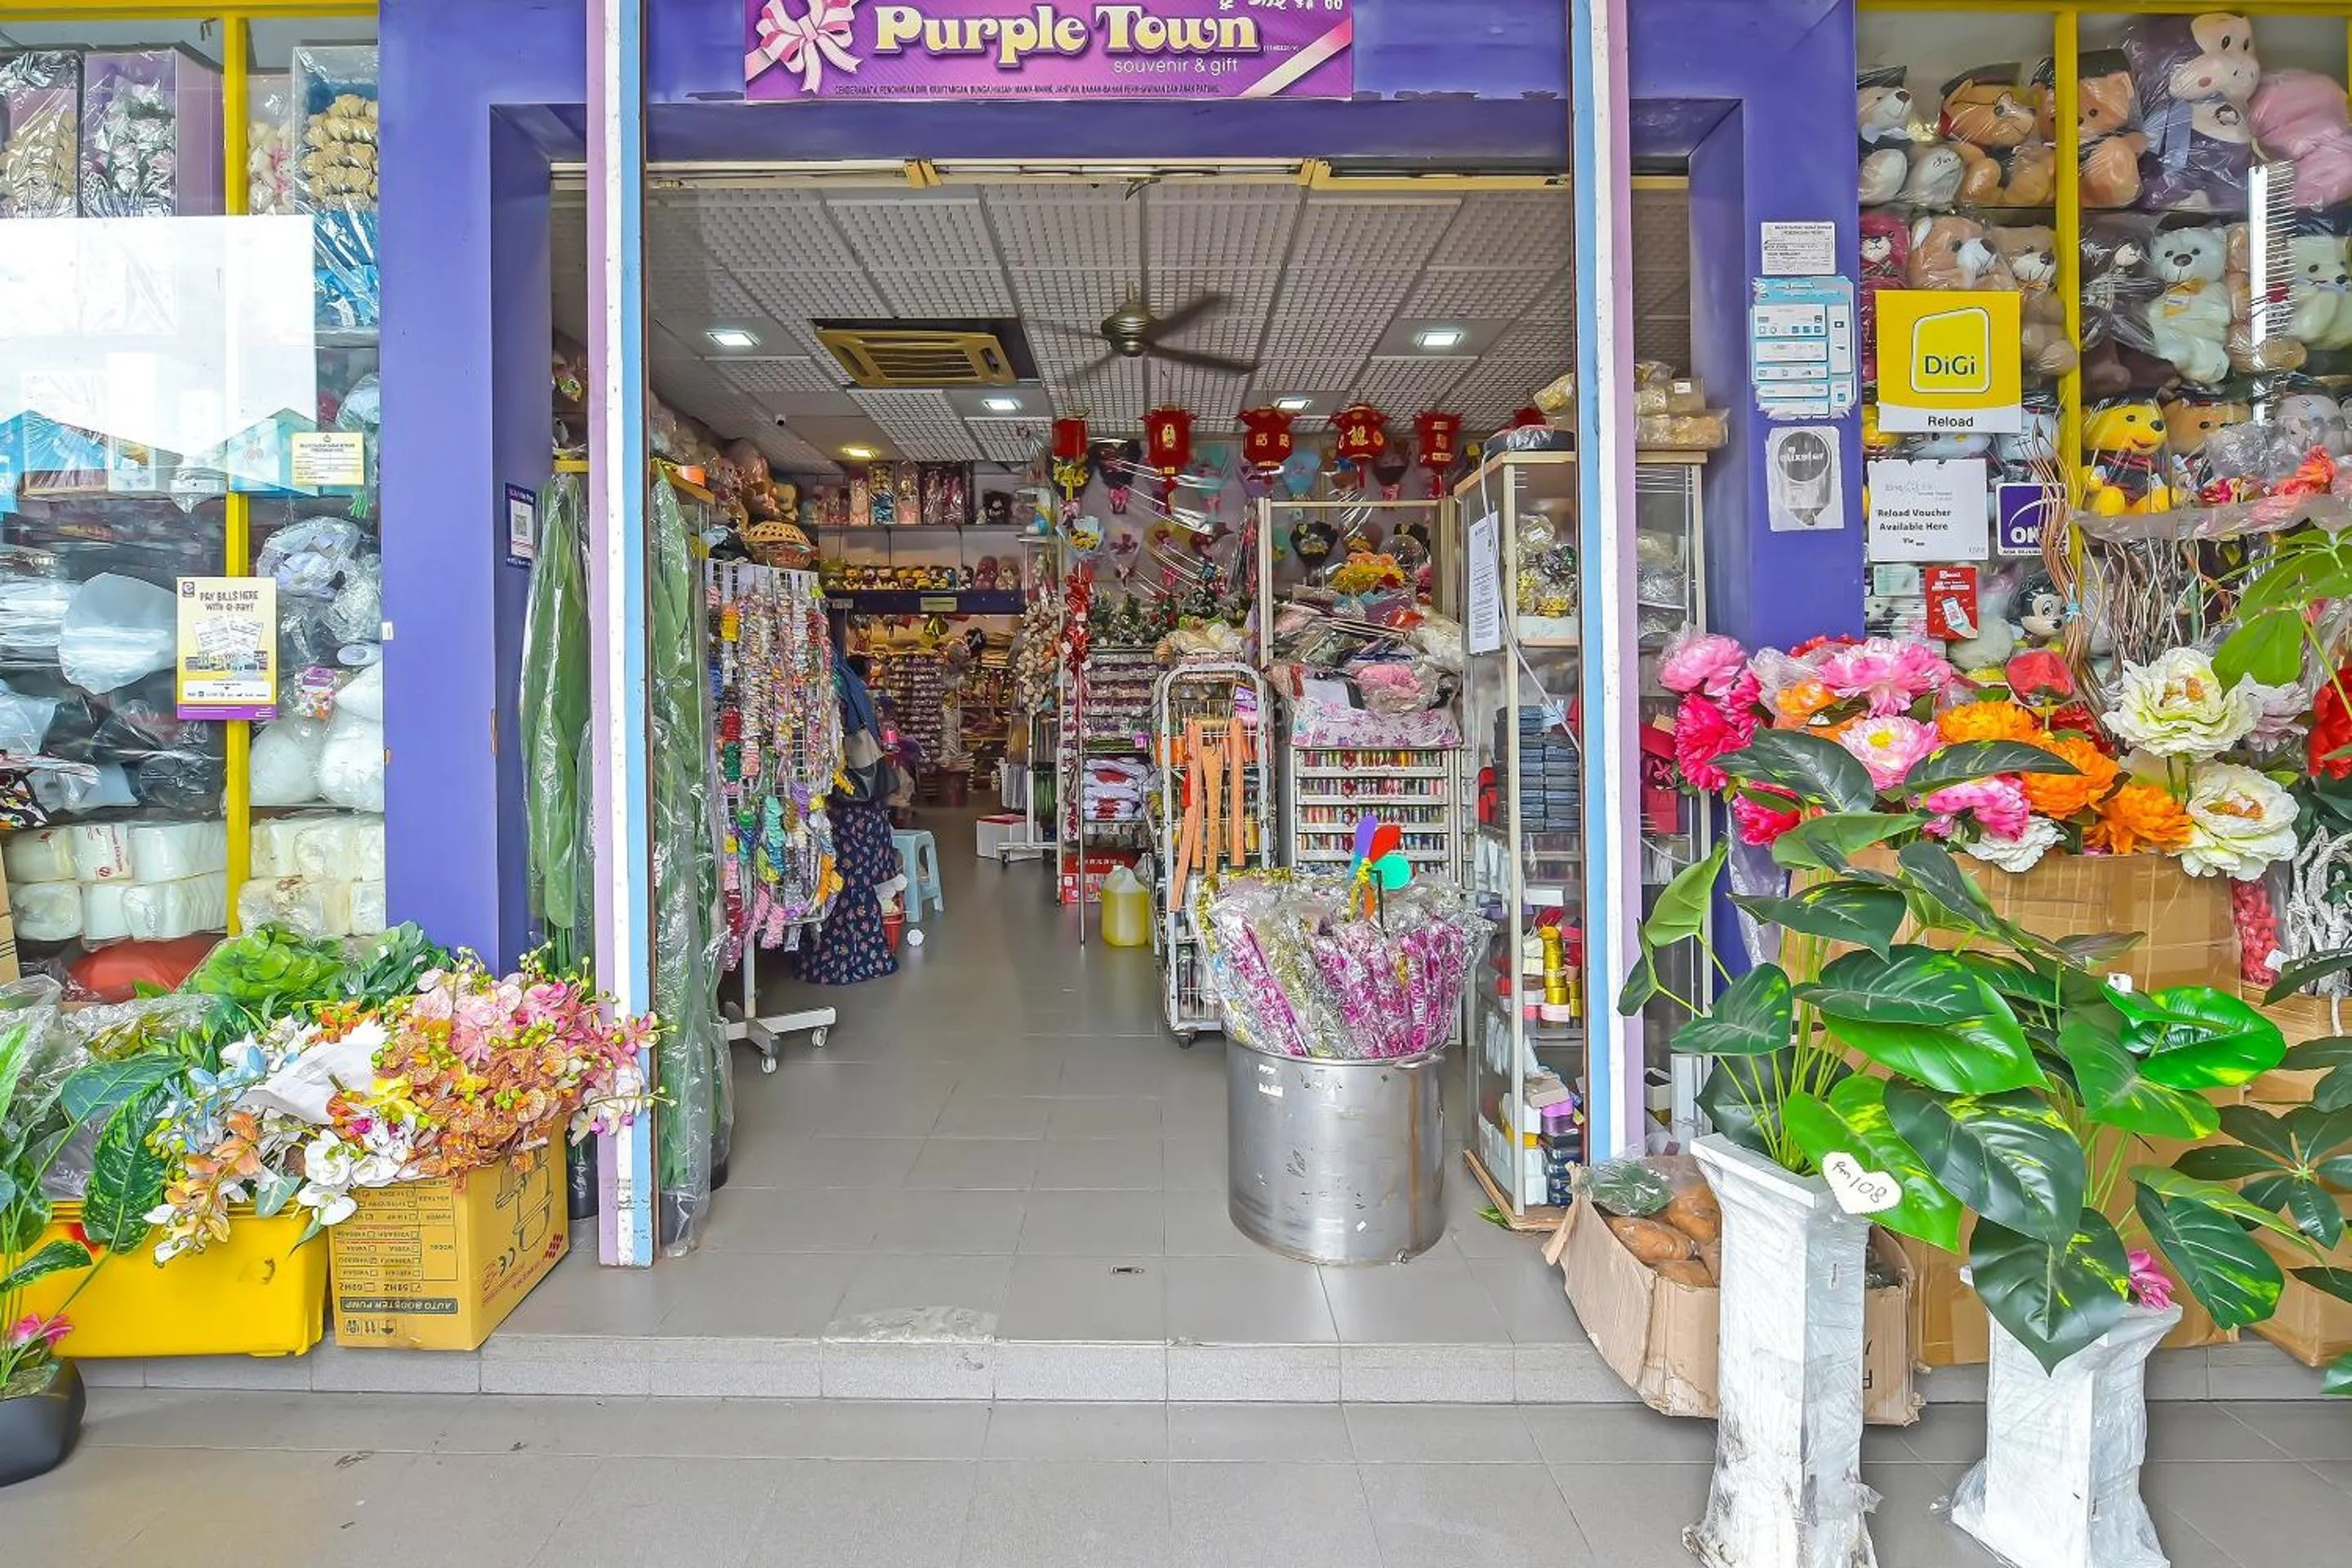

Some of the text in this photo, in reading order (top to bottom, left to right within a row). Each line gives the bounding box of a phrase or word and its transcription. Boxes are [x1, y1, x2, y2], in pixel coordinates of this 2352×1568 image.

[874, 5, 1258, 65] Purple Town
[1113, 57, 1238, 75] souvenir & gift
[1924, 354, 1976, 375] DiGi
[1927, 415, 1974, 427] Reload
[1878, 509, 1951, 517] Reload Voucher
[1879, 523, 1949, 531] Available Here
[199, 590, 259, 602] PAY BILLS HERE
[344, 1299, 453, 1311] AUTO BOOSTER PUMP
